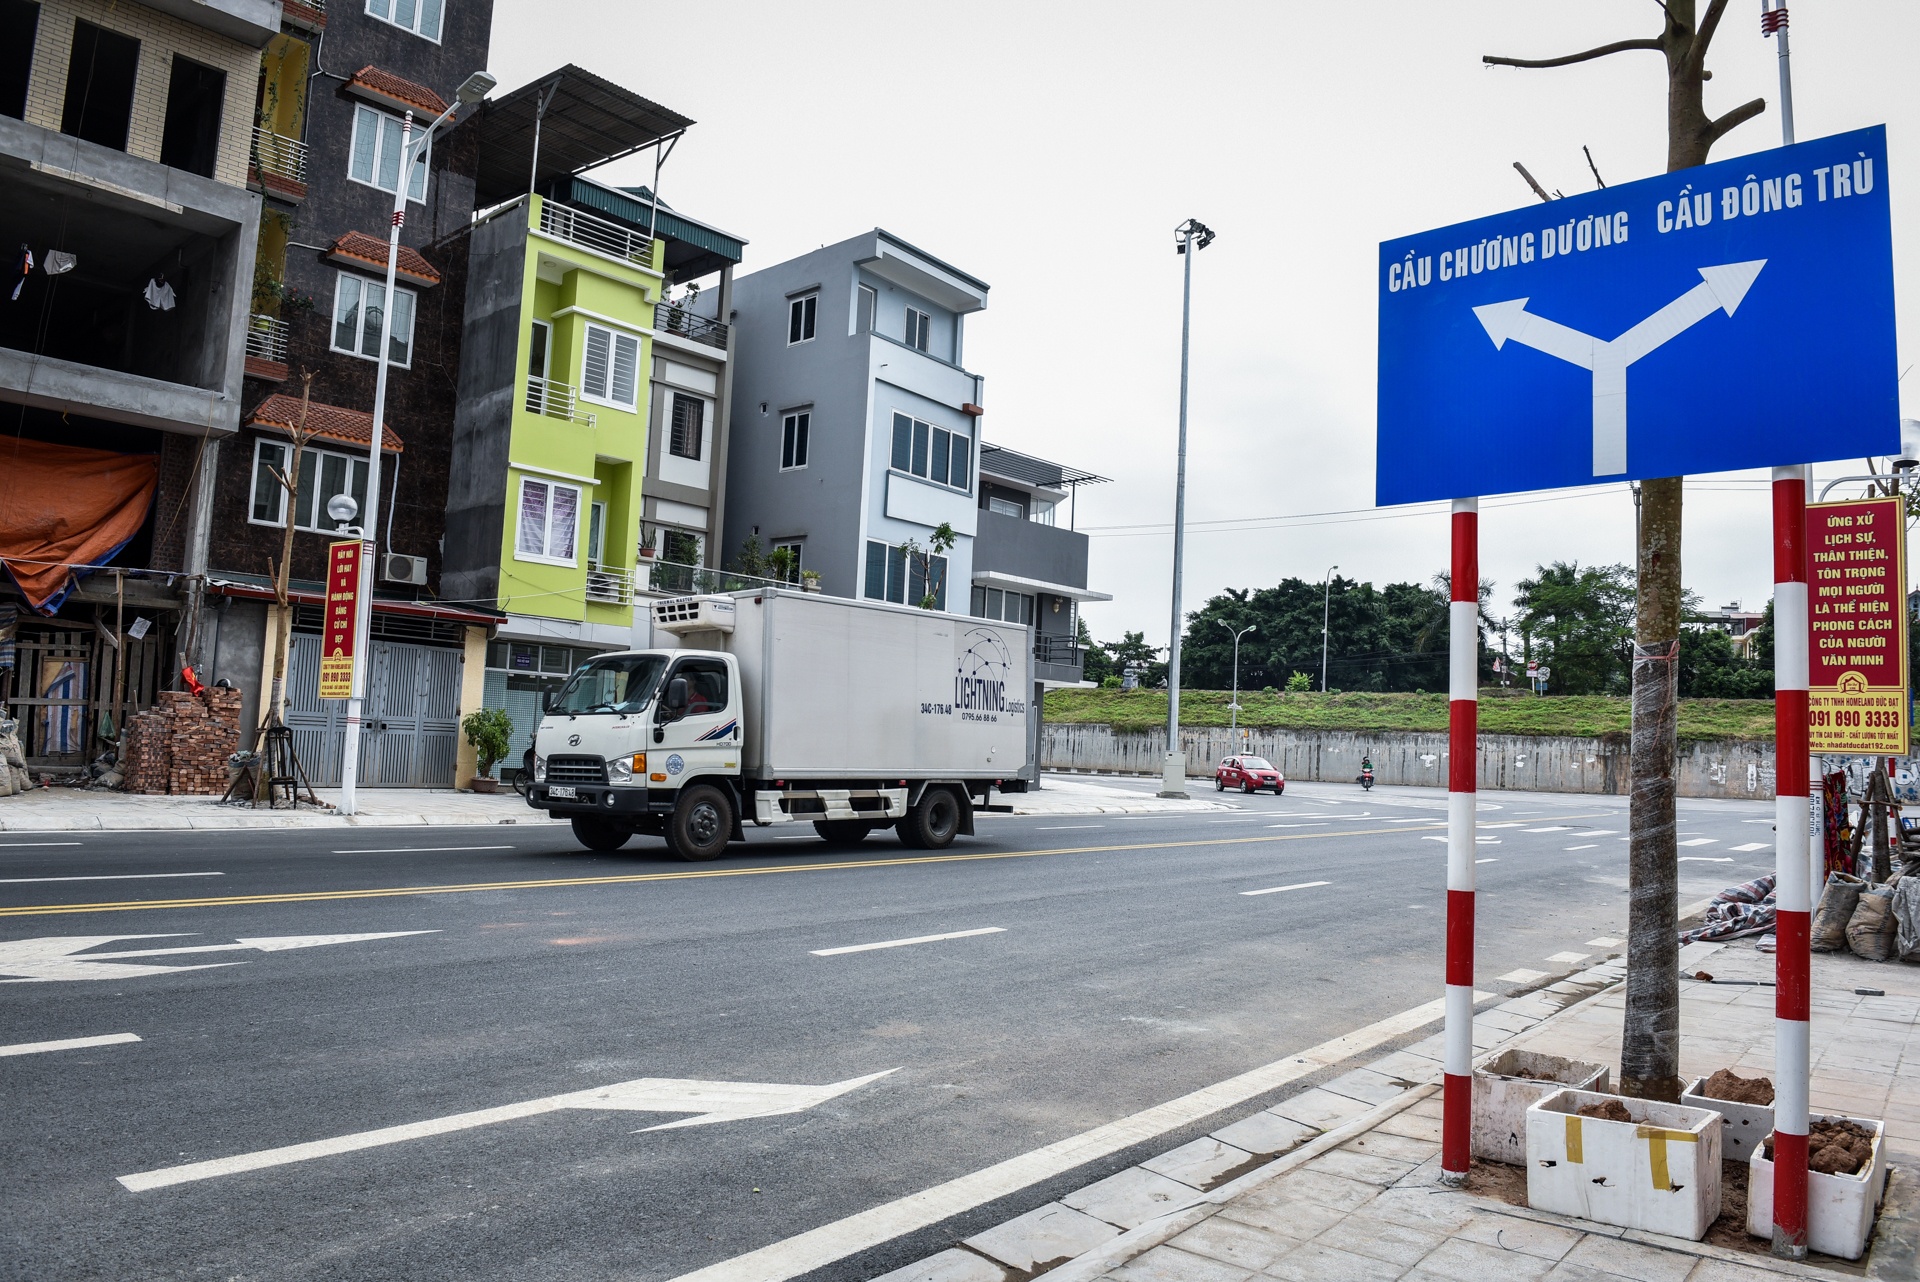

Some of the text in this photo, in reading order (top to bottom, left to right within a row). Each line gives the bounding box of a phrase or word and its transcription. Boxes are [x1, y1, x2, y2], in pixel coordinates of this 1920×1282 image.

[1657, 151, 1874, 234] CẦU ĐÔNG TRÙ
[1389, 210, 1629, 293] CẦU CHƯƠNG DƯƠNG
[1827, 510, 1875, 528] ỨNG XỬ
[1824, 531, 1876, 547] LỊCH SỰ,
[1813, 547, 1889, 563] THÂN THIỆN,
[344, 564, 353, 573] HAY
[1817, 566, 1886, 580] TÔN TRỌNG
[1819, 581, 1885, 599] MỌI NGƯỜI
[1815, 598, 1889, 615] LÀ THỂ HIỆN
[1813, 617, 1892, 632] PHONG CÁCH
[1819, 634, 1886, 649] CỦA NGƯỜI
[1822, 653, 1884, 666] VĂN MINH
[955, 676, 1025, 717] LIGHTNING Logistics
[1823, 697, 1829, 707] TY
[1831, 697, 1845, 707] TNHH
[1846, 697, 1875, 707] HOMELAND
[1876, 695, 1887, 707] ĐỨC
[1888, 697, 1899, 709] ĐẠT
[920, 703, 952, 715] 34C-176.48
[961, 712, 998, 722] 0795.66 88 66
[1809, 710, 1899, 728] 091 890 3333
[1824, 731, 1833, 739] CAO
[1834, 729, 1845, 739] NHẤT
[1849, 730, 1861, 739] CHẤT
[1887, 730, 1899, 740] NHẤT
[1827, 741, 1899, 750] nhadatducdat192.com
